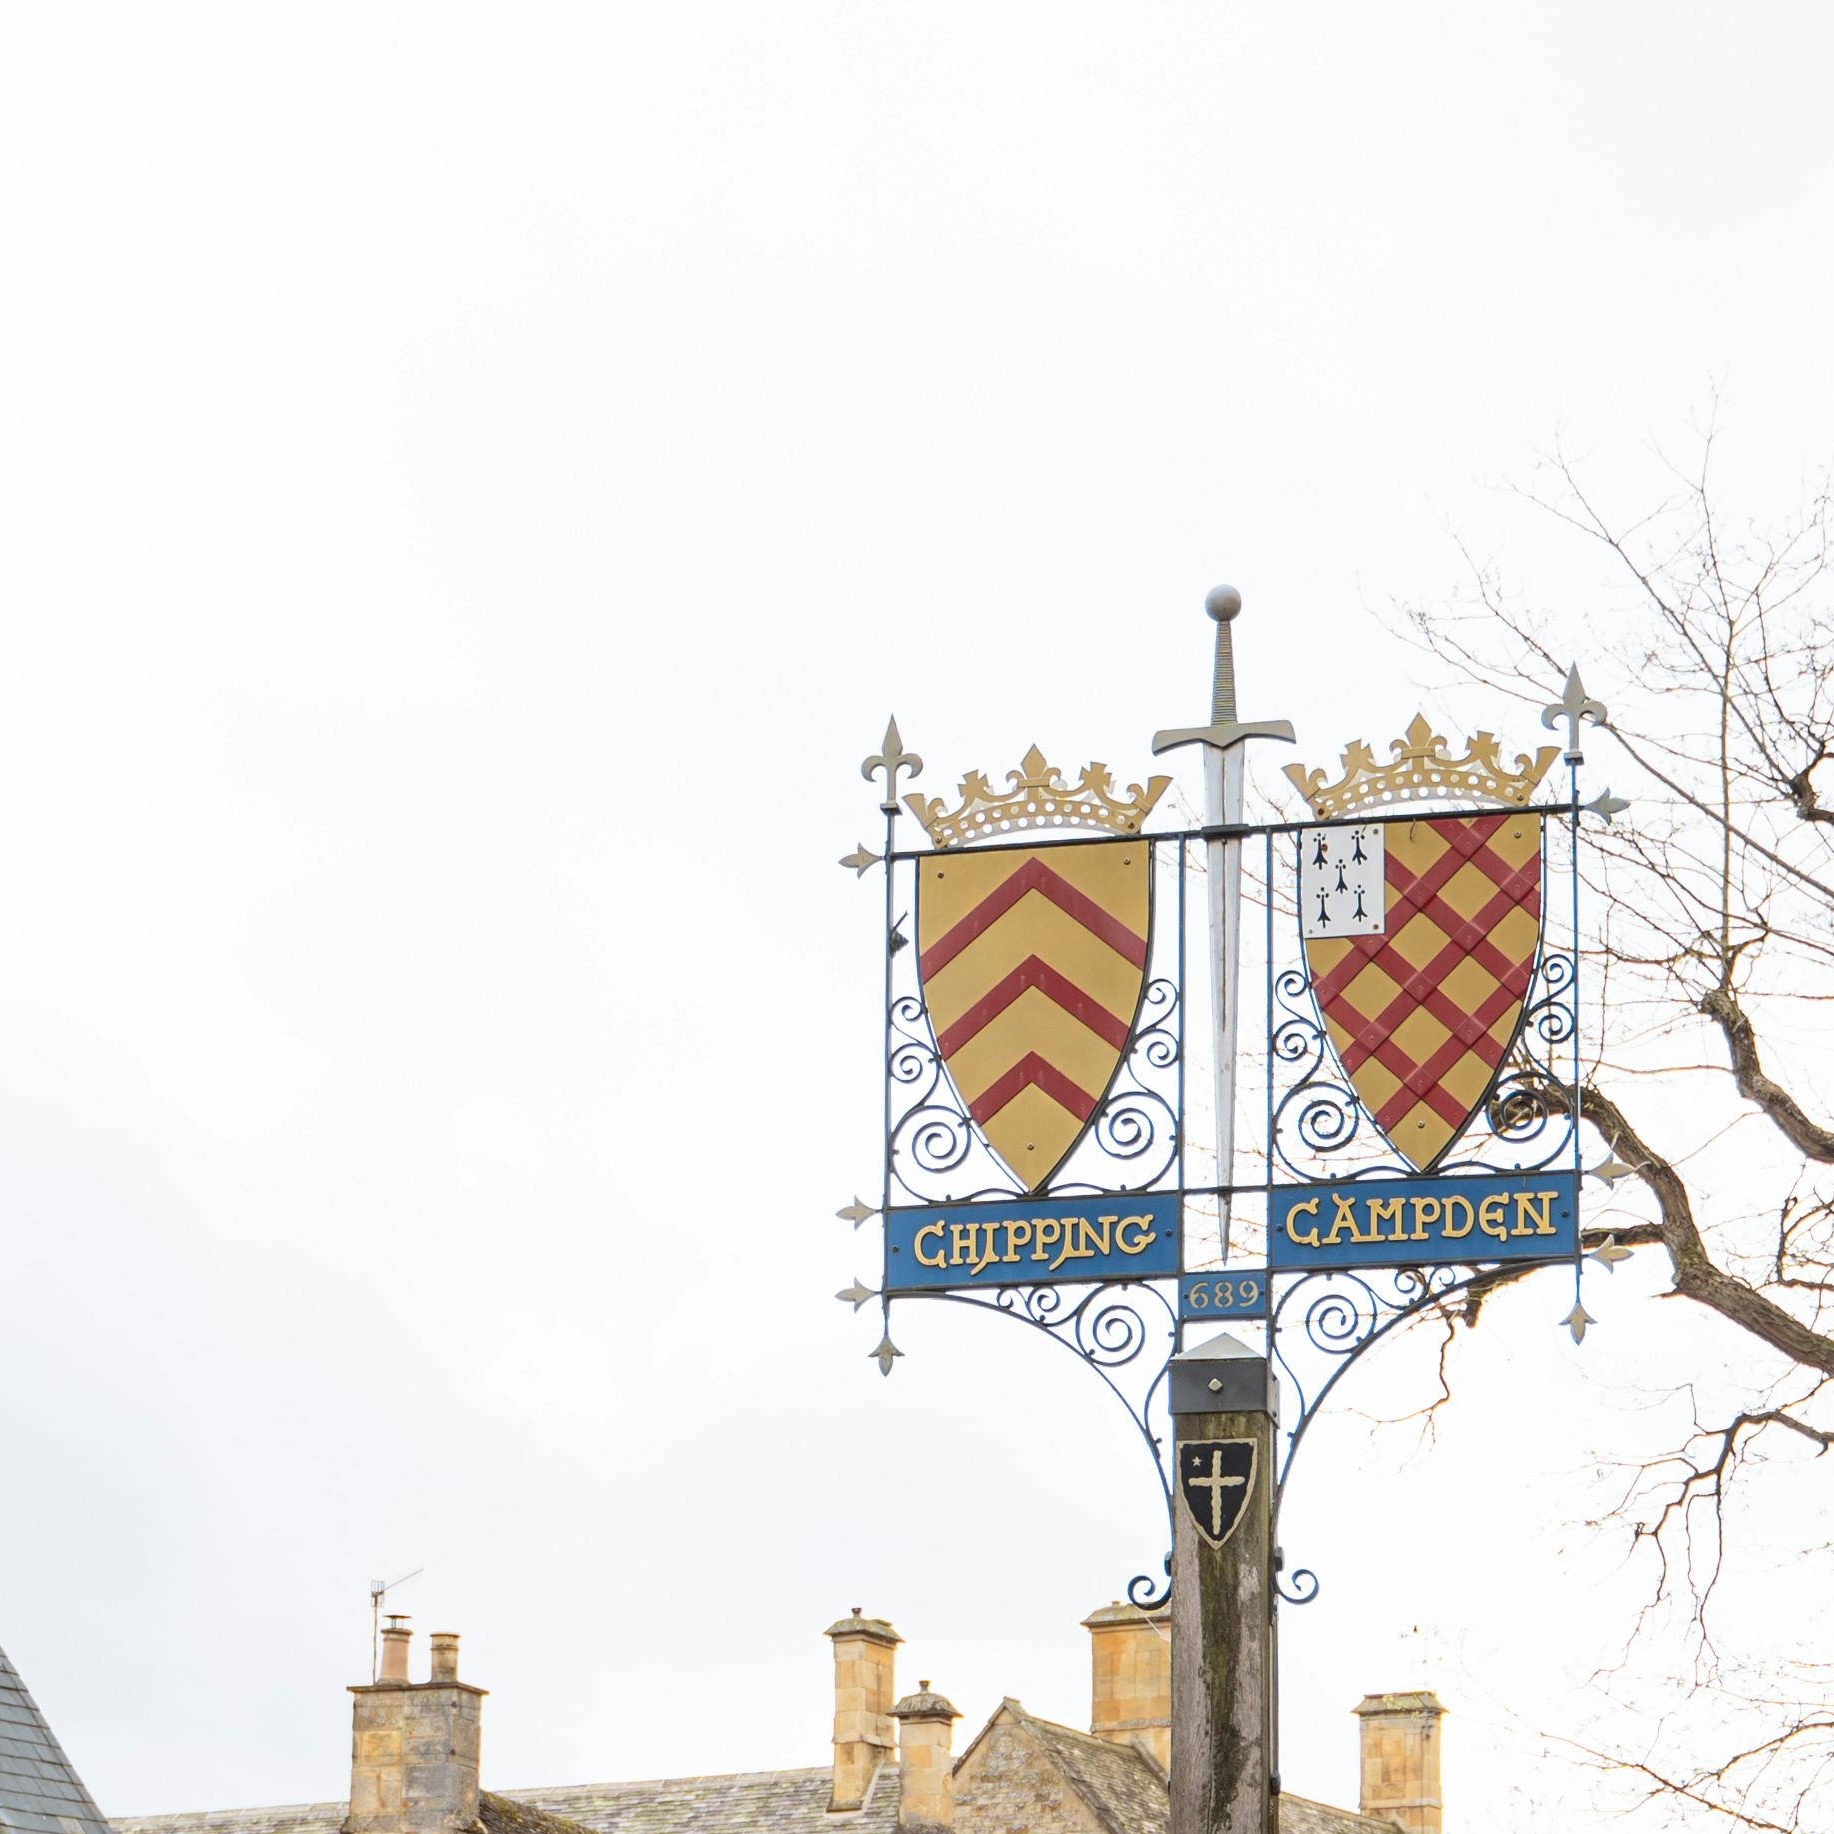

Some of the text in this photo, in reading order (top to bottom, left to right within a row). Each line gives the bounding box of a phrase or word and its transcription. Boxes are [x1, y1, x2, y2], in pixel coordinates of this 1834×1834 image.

[914, 1191, 1559, 1276] CHIPPING CAMPDEN
[1189, 1280, 1259, 1310] 689
